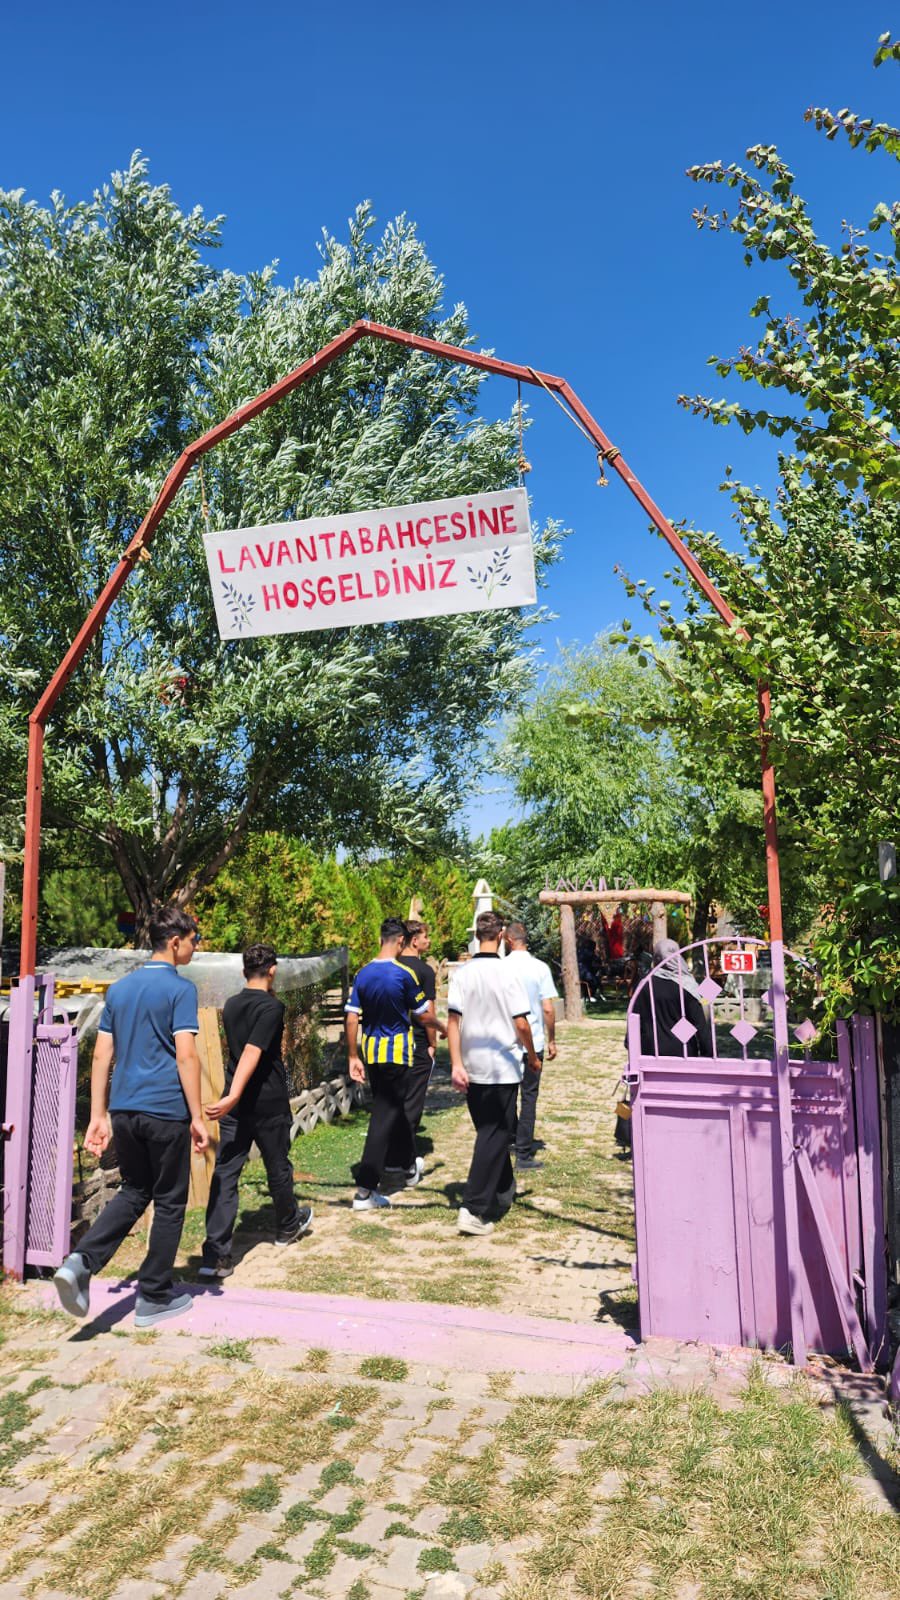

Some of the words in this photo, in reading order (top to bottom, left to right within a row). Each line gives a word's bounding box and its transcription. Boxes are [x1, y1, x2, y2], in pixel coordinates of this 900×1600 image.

[217, 501, 518, 574] LAVANTABAHÇESİNE
[261, 553, 458, 612] HOŞGELDİNİZ
[730, 954, 746, 970] 51
